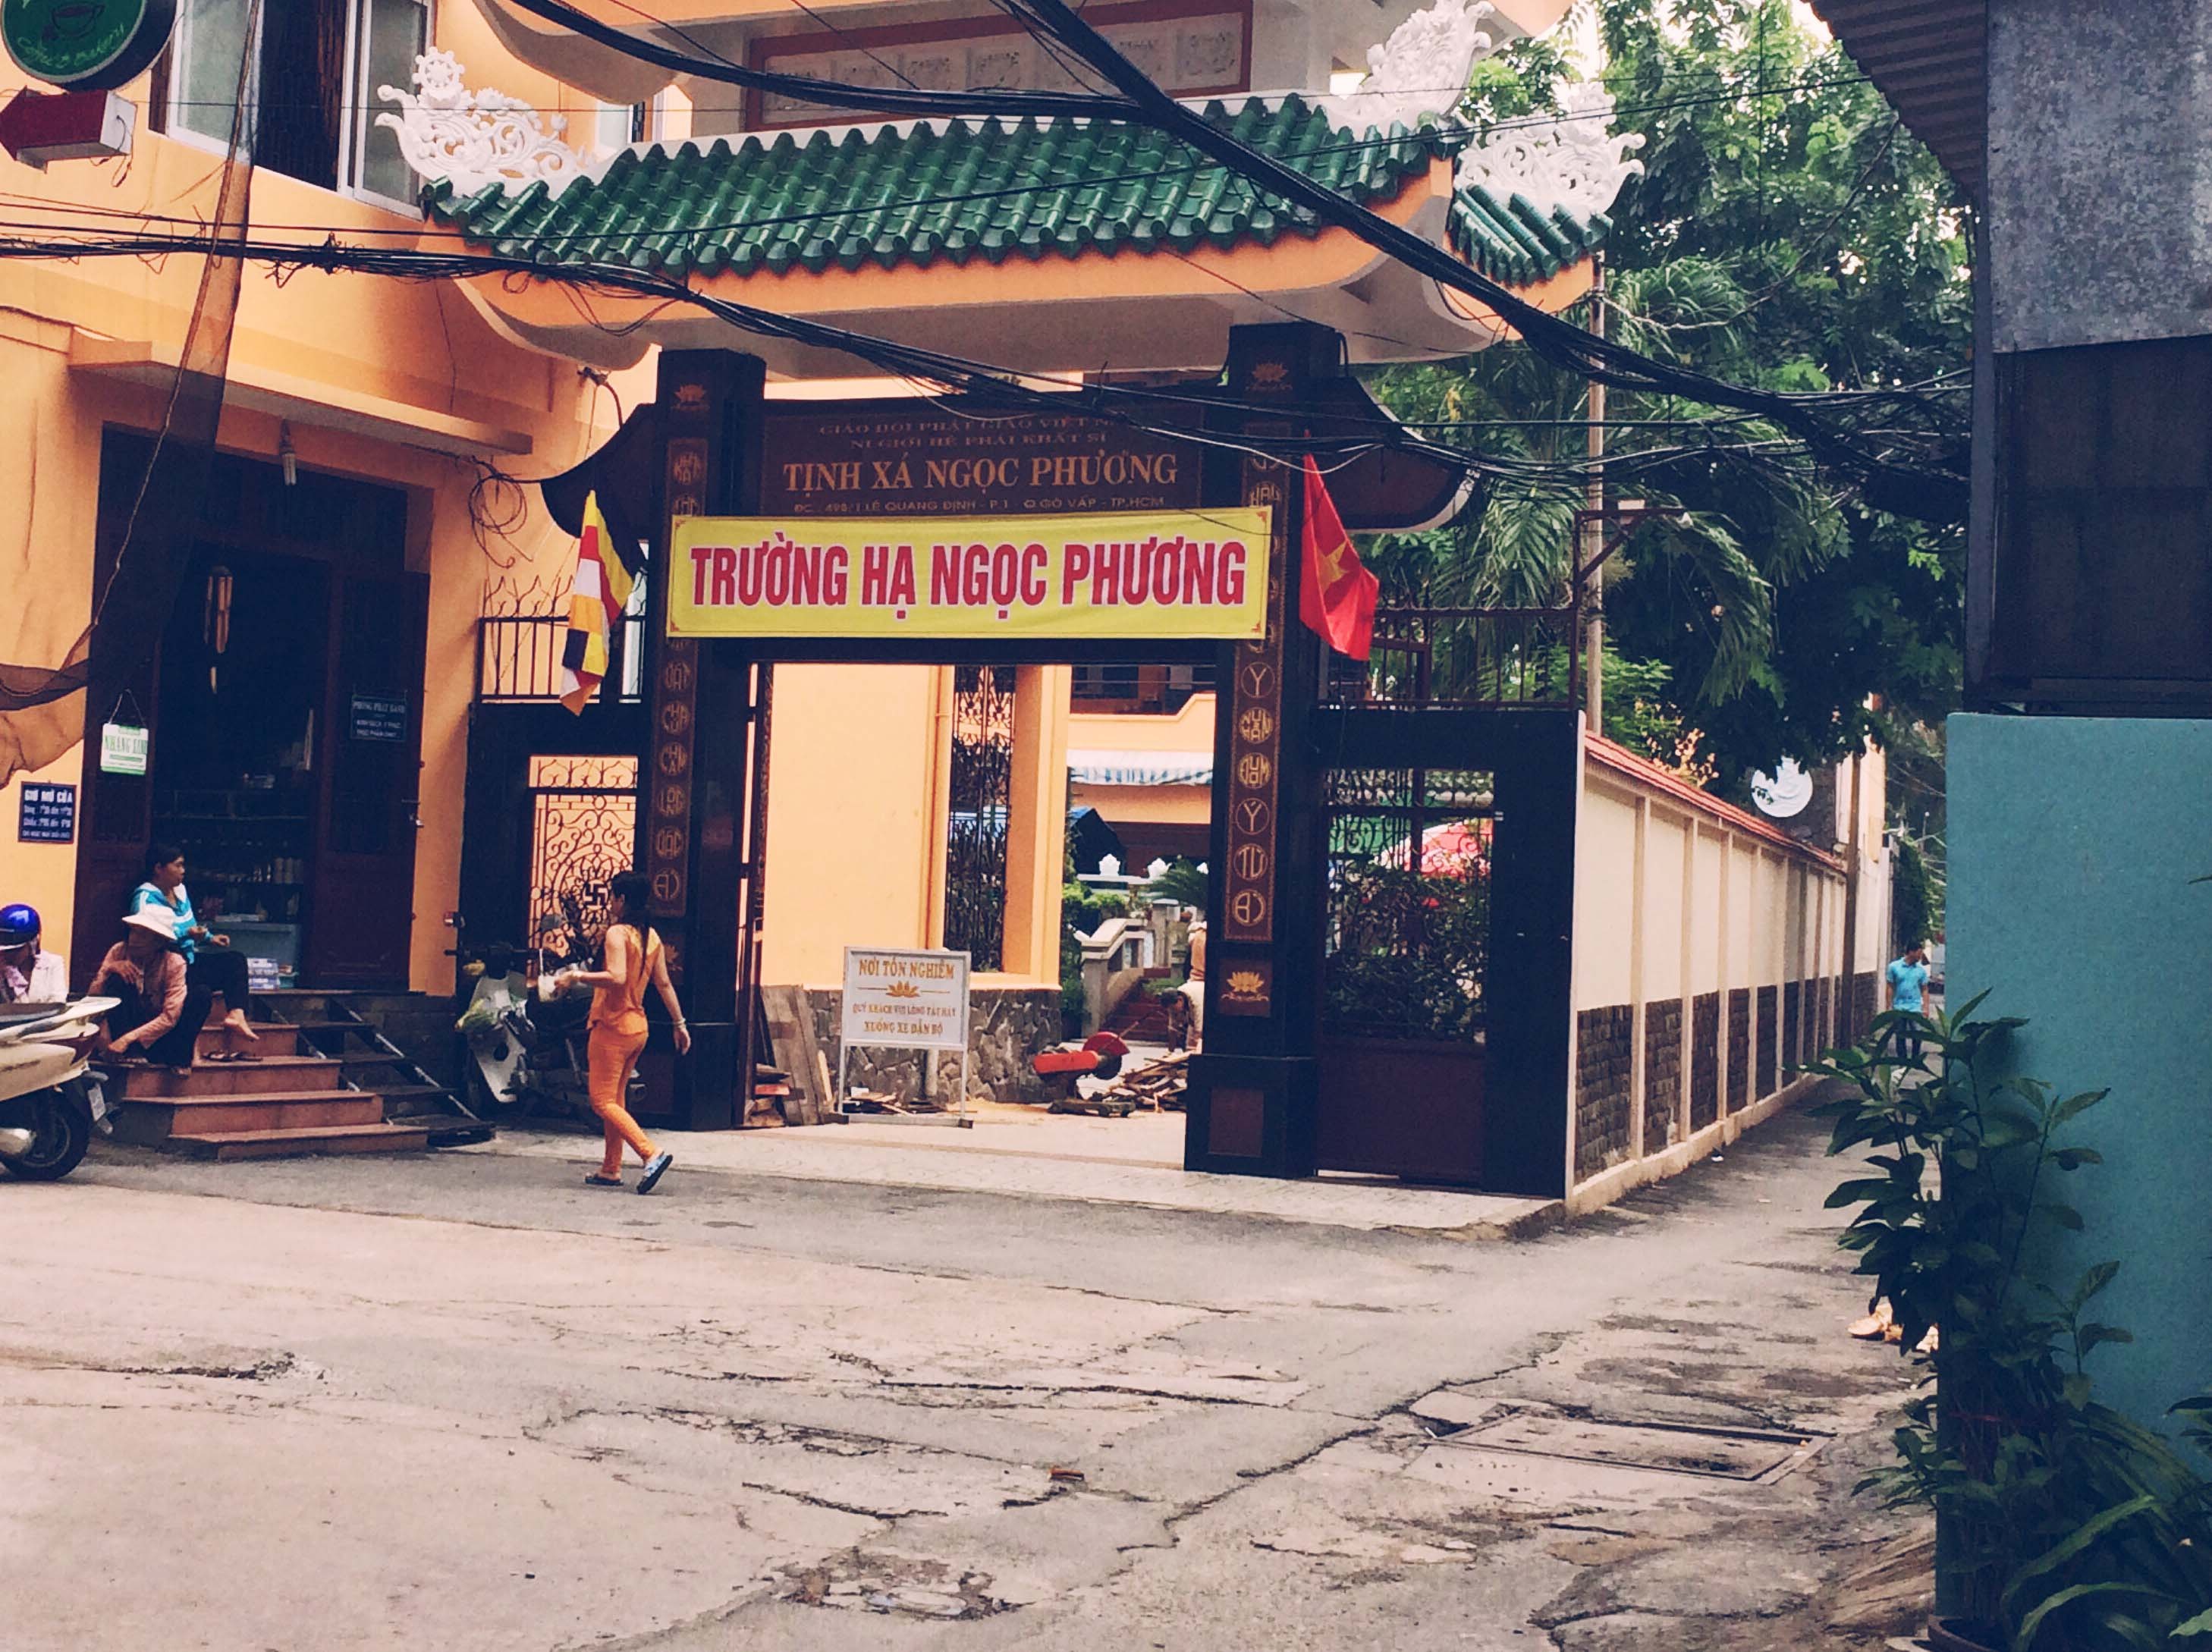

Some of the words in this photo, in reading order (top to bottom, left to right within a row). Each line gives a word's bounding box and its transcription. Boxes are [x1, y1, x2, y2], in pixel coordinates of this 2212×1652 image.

[783, 460, 862, 498] TỊNH
[870, 451, 913, 490] XÁ
[923, 456, 1020, 494] NGỌC
[1029, 448, 1178, 487] PHƯƠNG
[884, 498, 938, 512] QUANG
[690, 530, 849, 607] TRƯỜNG
[862, 544, 917, 620] HẠ
[930, 543, 1048, 620] NGỌC
[1060, 535, 1246, 605] PHƯƠNG
[859, 956, 880, 976] NƠI
[882, 956, 907, 977] TÔN
[909, 959, 954, 980] NGHIÊM
[897, 1022, 910, 1034] XE
